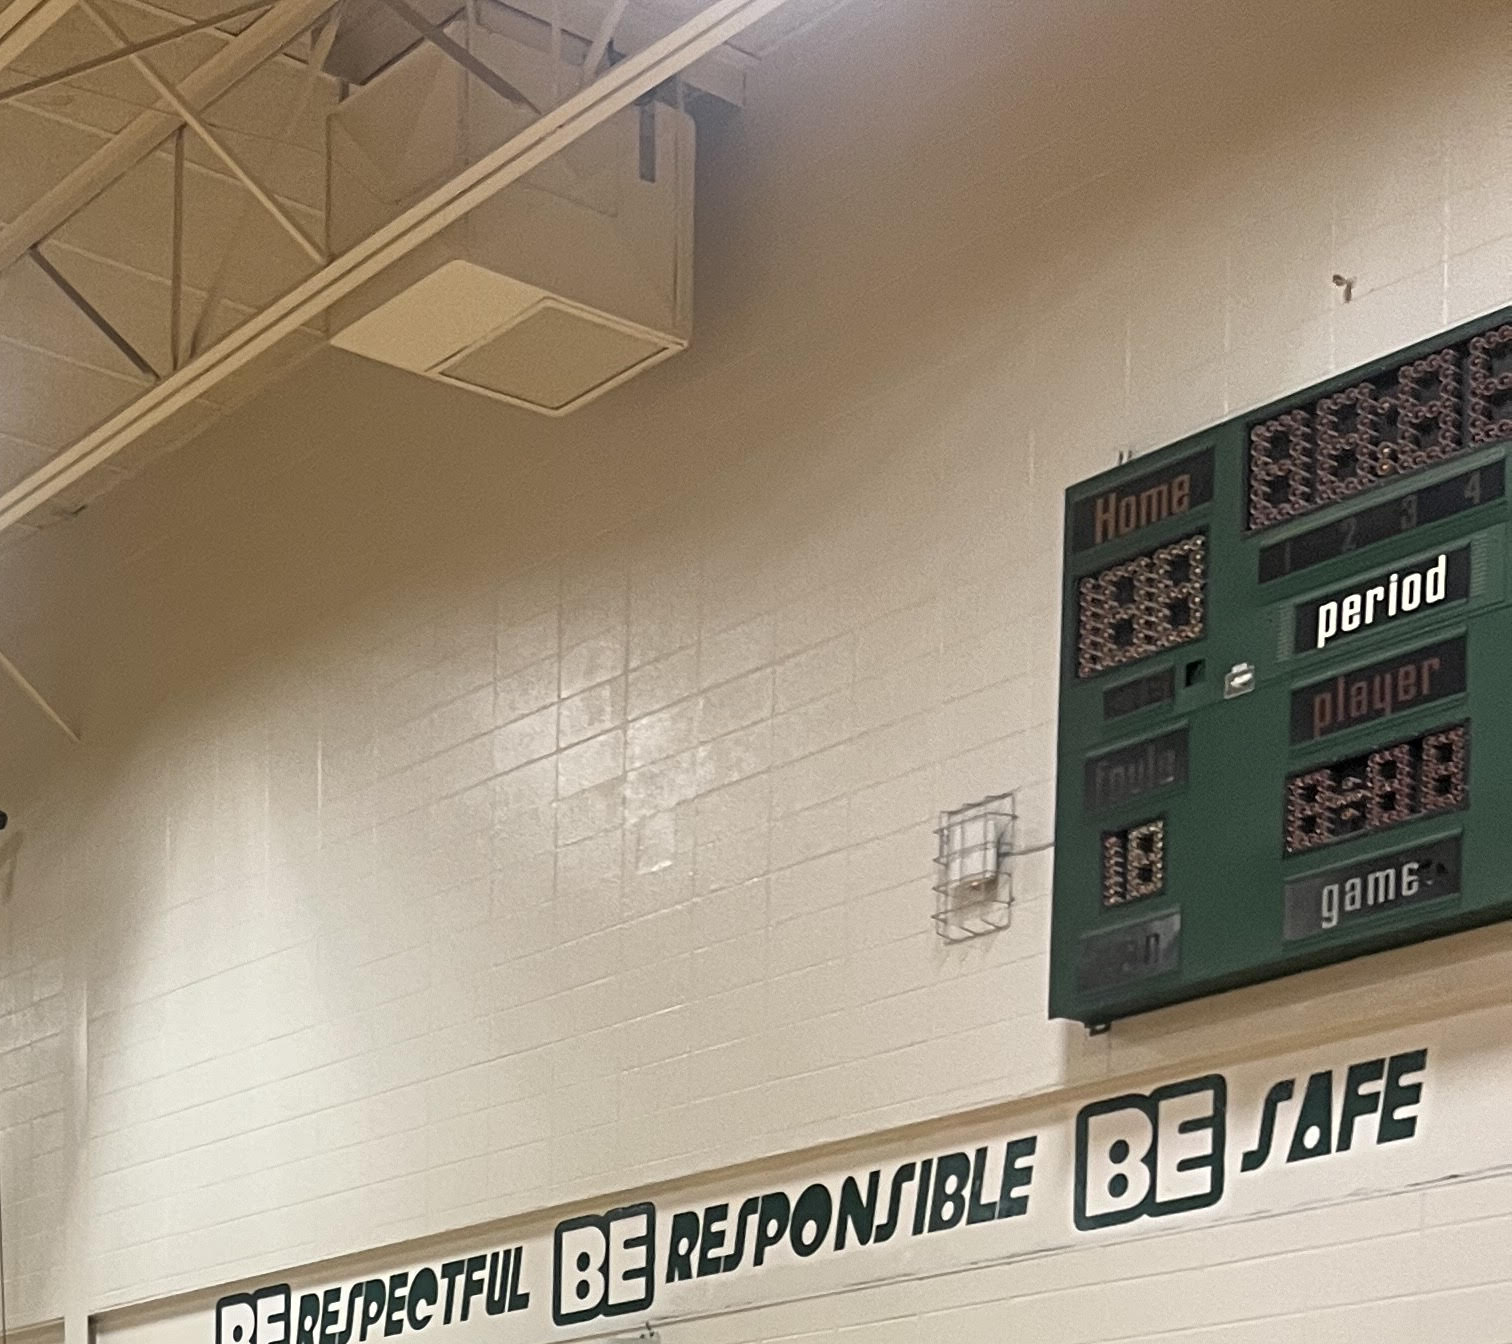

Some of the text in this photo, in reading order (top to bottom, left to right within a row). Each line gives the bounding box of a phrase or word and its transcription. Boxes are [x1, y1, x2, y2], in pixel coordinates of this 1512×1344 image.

[1094, 476, 1190, 543] Home
[1317, 554, 1447, 648] period
[1312, 657, 1441, 740] player
[1322, 862, 1419, 929] game
[553, 1202, 655, 1325] BE
[665, 1135, 1037, 1284] RESPONSIBLE
[1074, 1073, 1227, 1231] BE
[1241, 1048, 1429, 1173] SAFE
